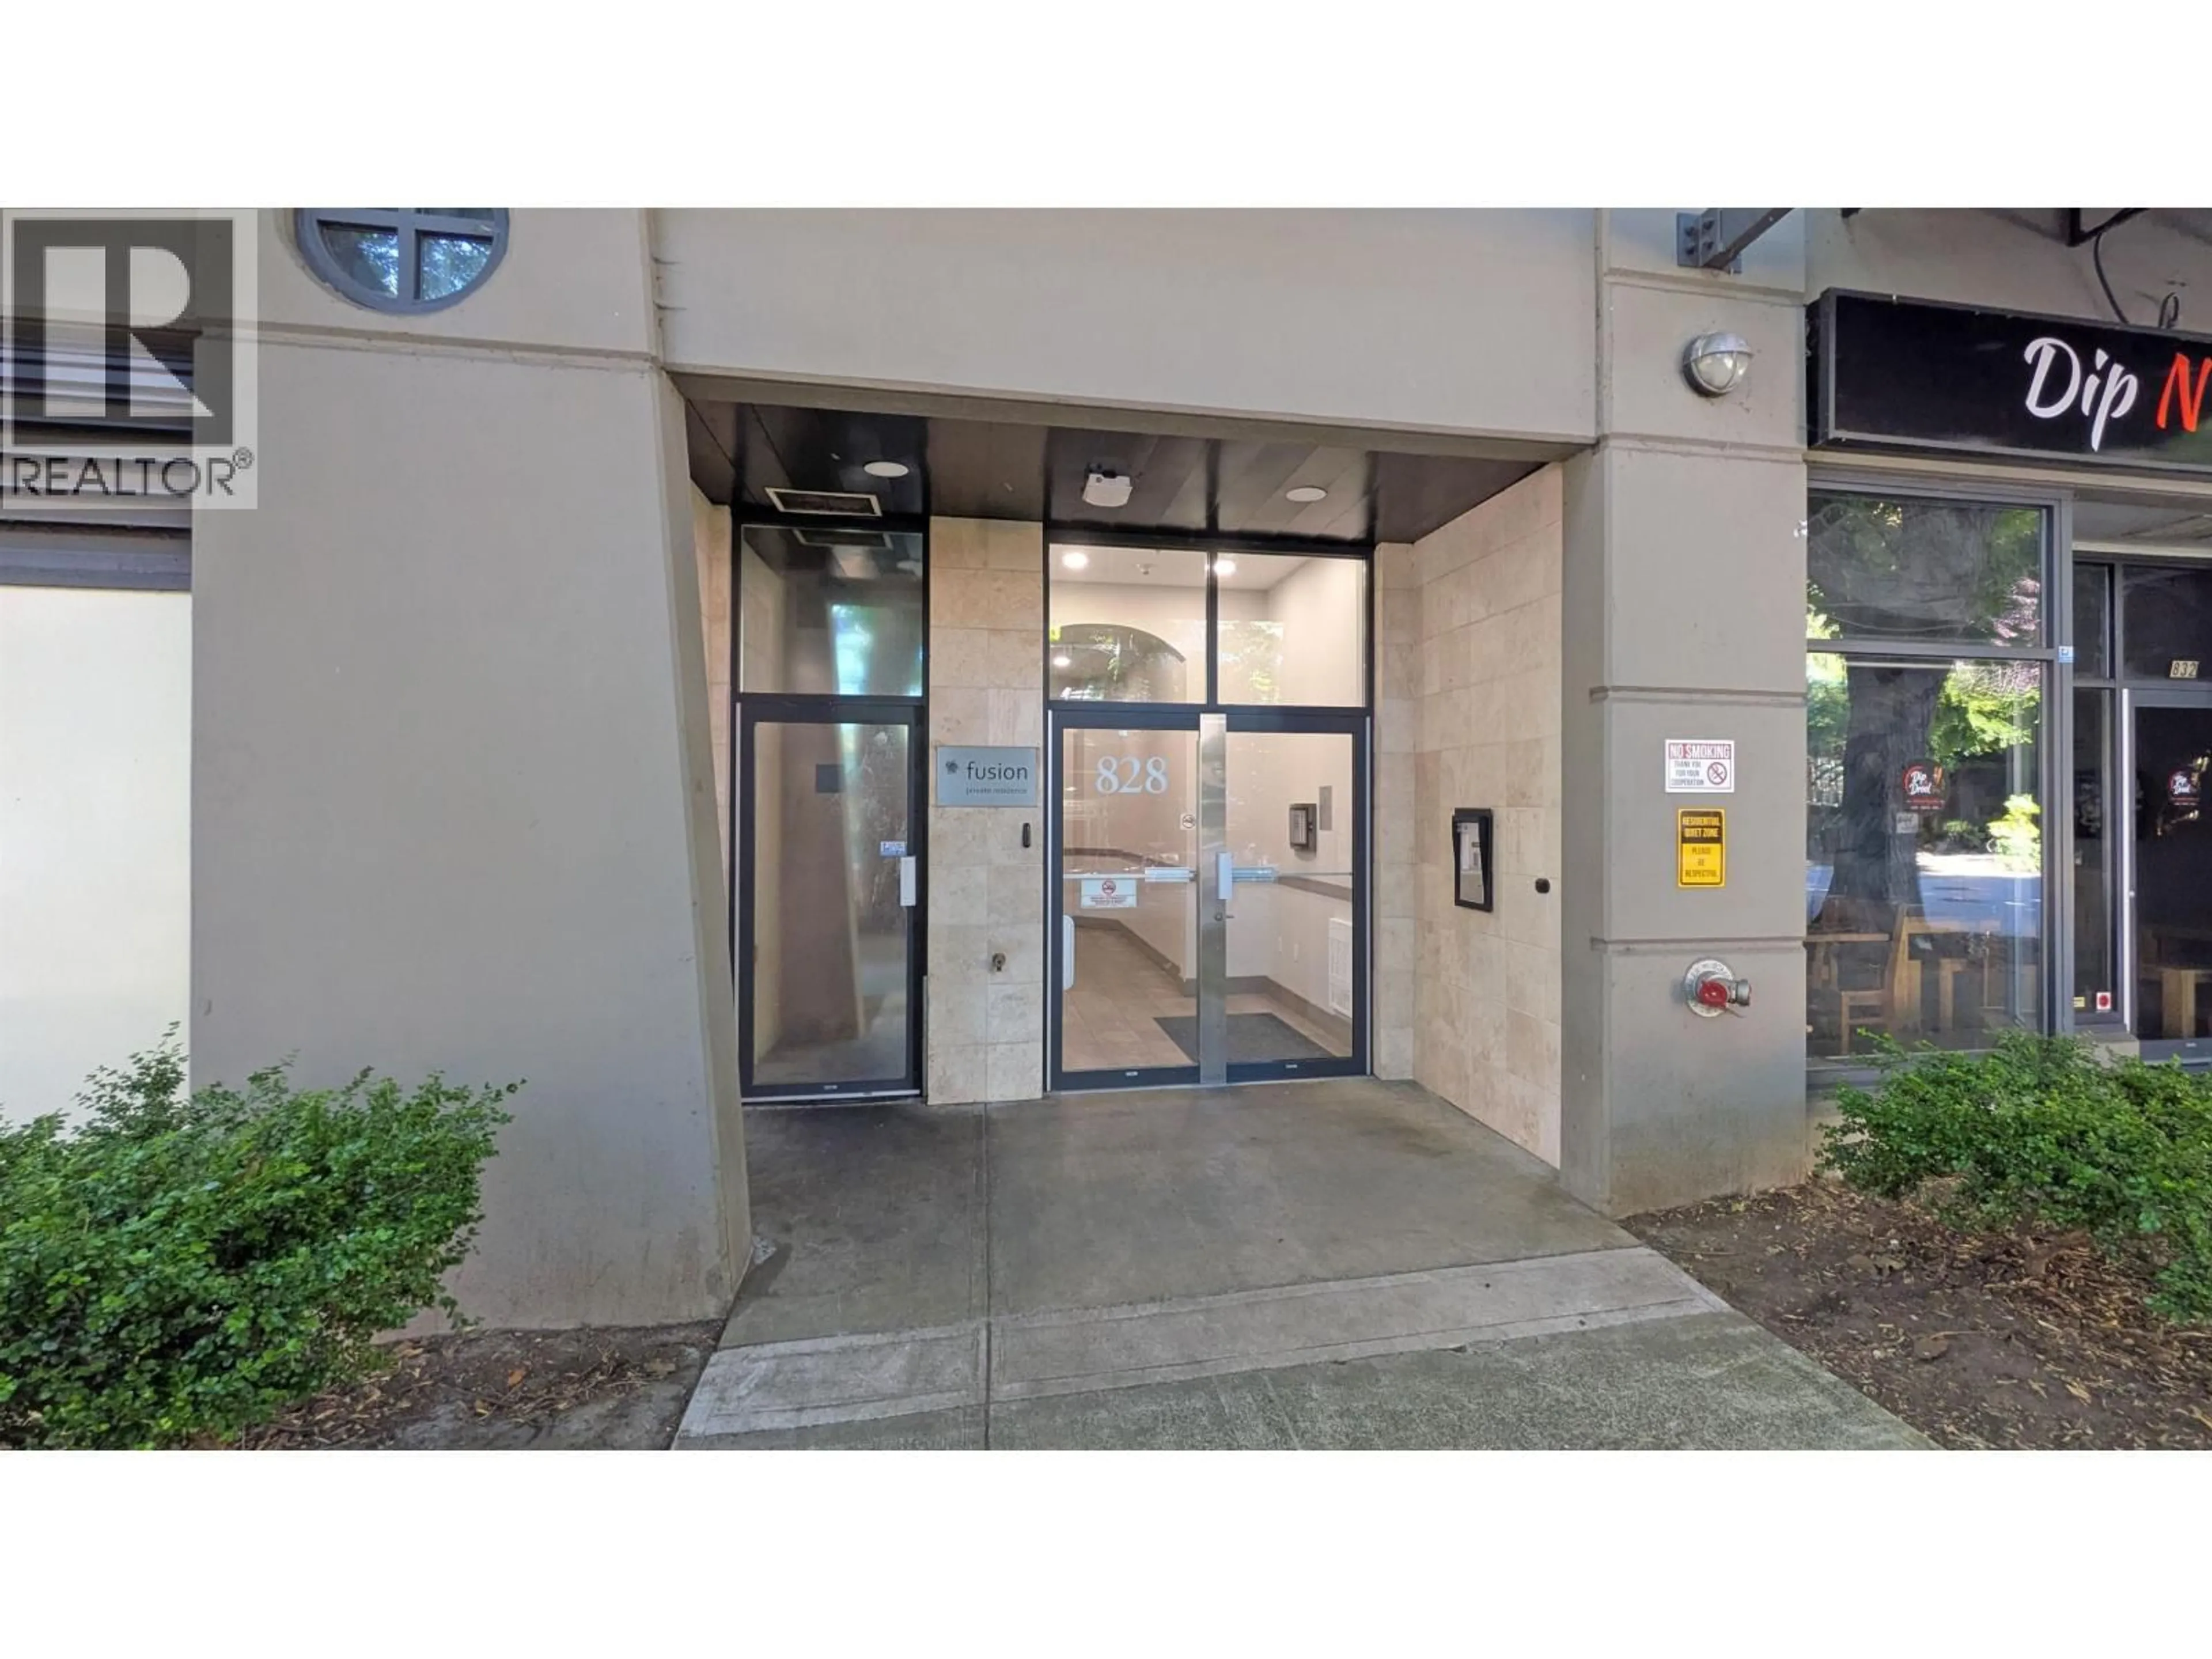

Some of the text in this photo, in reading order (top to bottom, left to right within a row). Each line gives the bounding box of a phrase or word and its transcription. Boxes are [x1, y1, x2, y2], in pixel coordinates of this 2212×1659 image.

[2024, 336, 2212, 452] Dip N
[2172, 662, 2196, 677] 832
[1670, 743, 1730, 759] NO SMOKING
[966, 760, 1028, 780] fusion
[1095, 755, 1168, 794] 828
